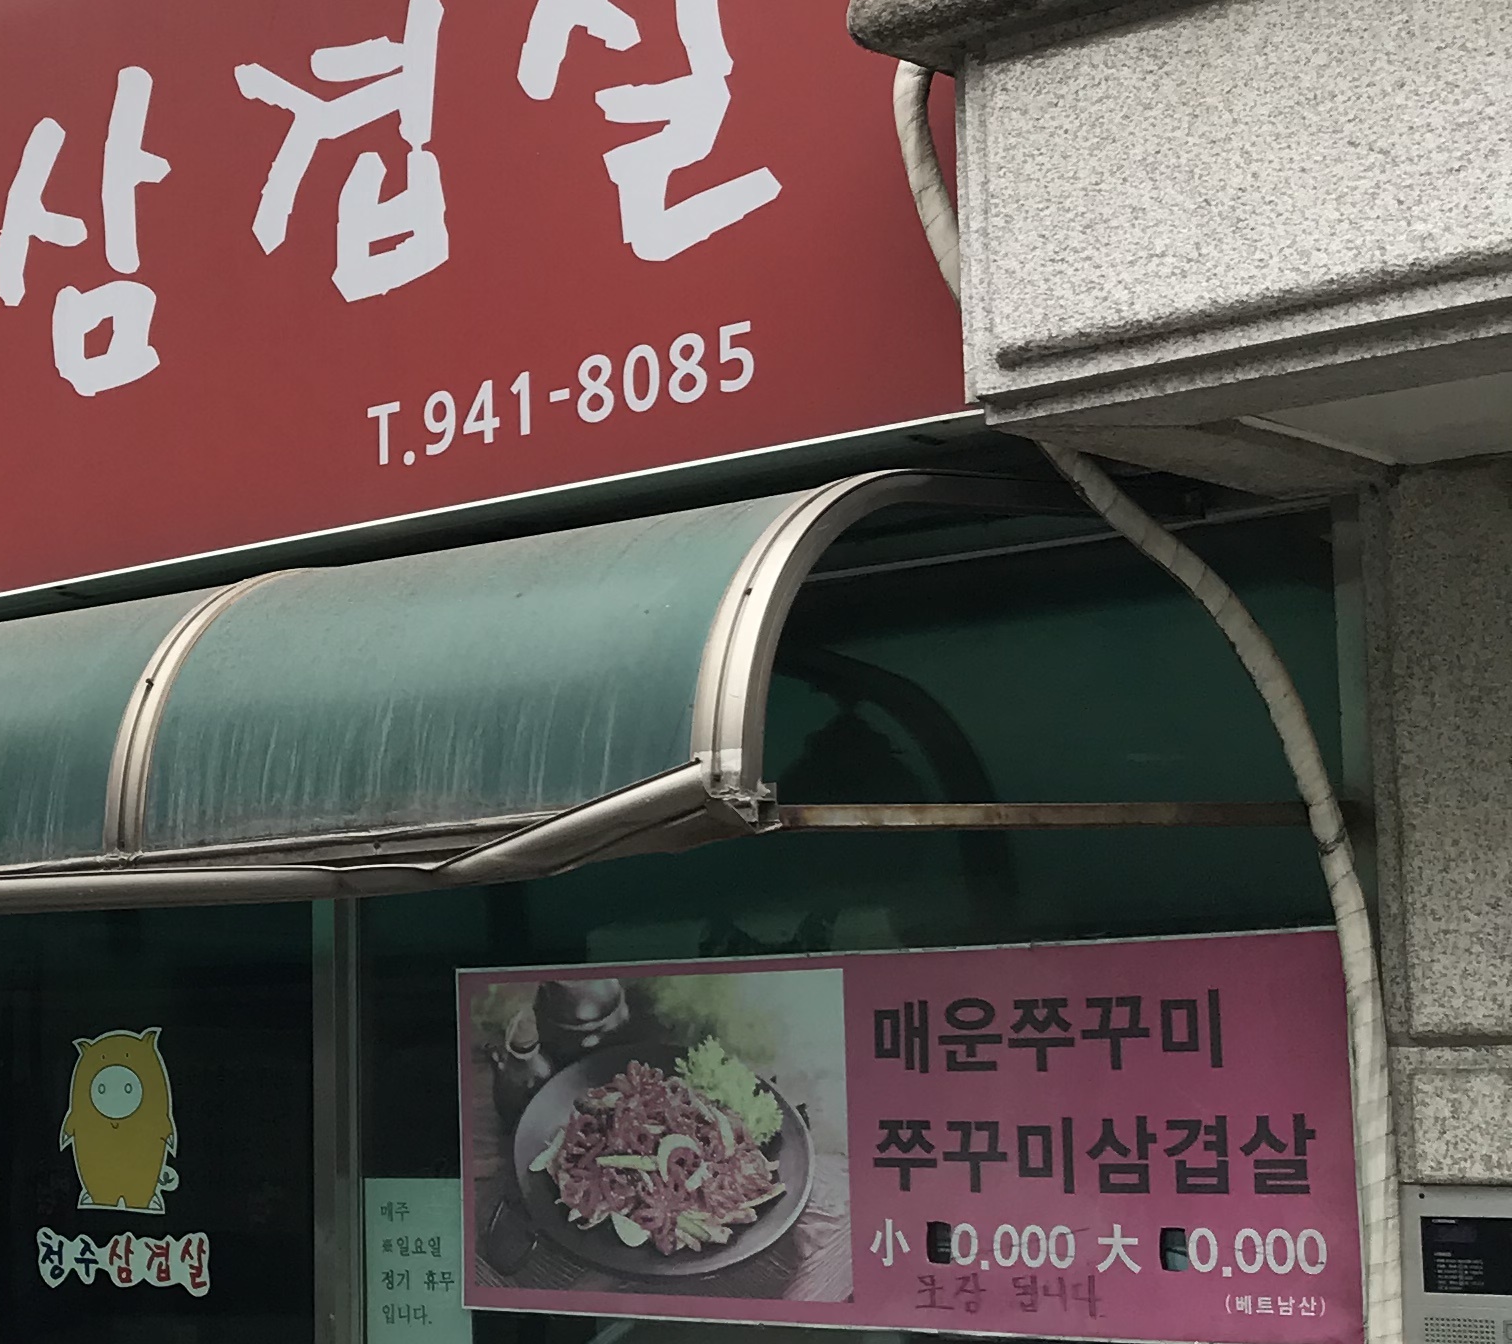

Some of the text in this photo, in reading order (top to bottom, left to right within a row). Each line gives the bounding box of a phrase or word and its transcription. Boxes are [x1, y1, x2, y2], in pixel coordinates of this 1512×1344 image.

[365, 320, 758, 467] T.941-8085
[873, 988, 1224, 1073] 매운쭈꾸미
[872, 1113, 1317, 1195] 쭈꾸미삼겹살
[380, 1201, 410, 1222] 매주
[926, 1220, 1075, 1271] 0.000
[1096, 1223, 1142, 1275] 大
[1159, 1226, 1328, 1278] 0.000
[381, 1269, 455, 1292] 정기 휴무
[382, 1304, 432, 1325] 입니다.
[1225, 1294, 1327, 1318] (베트남산)
